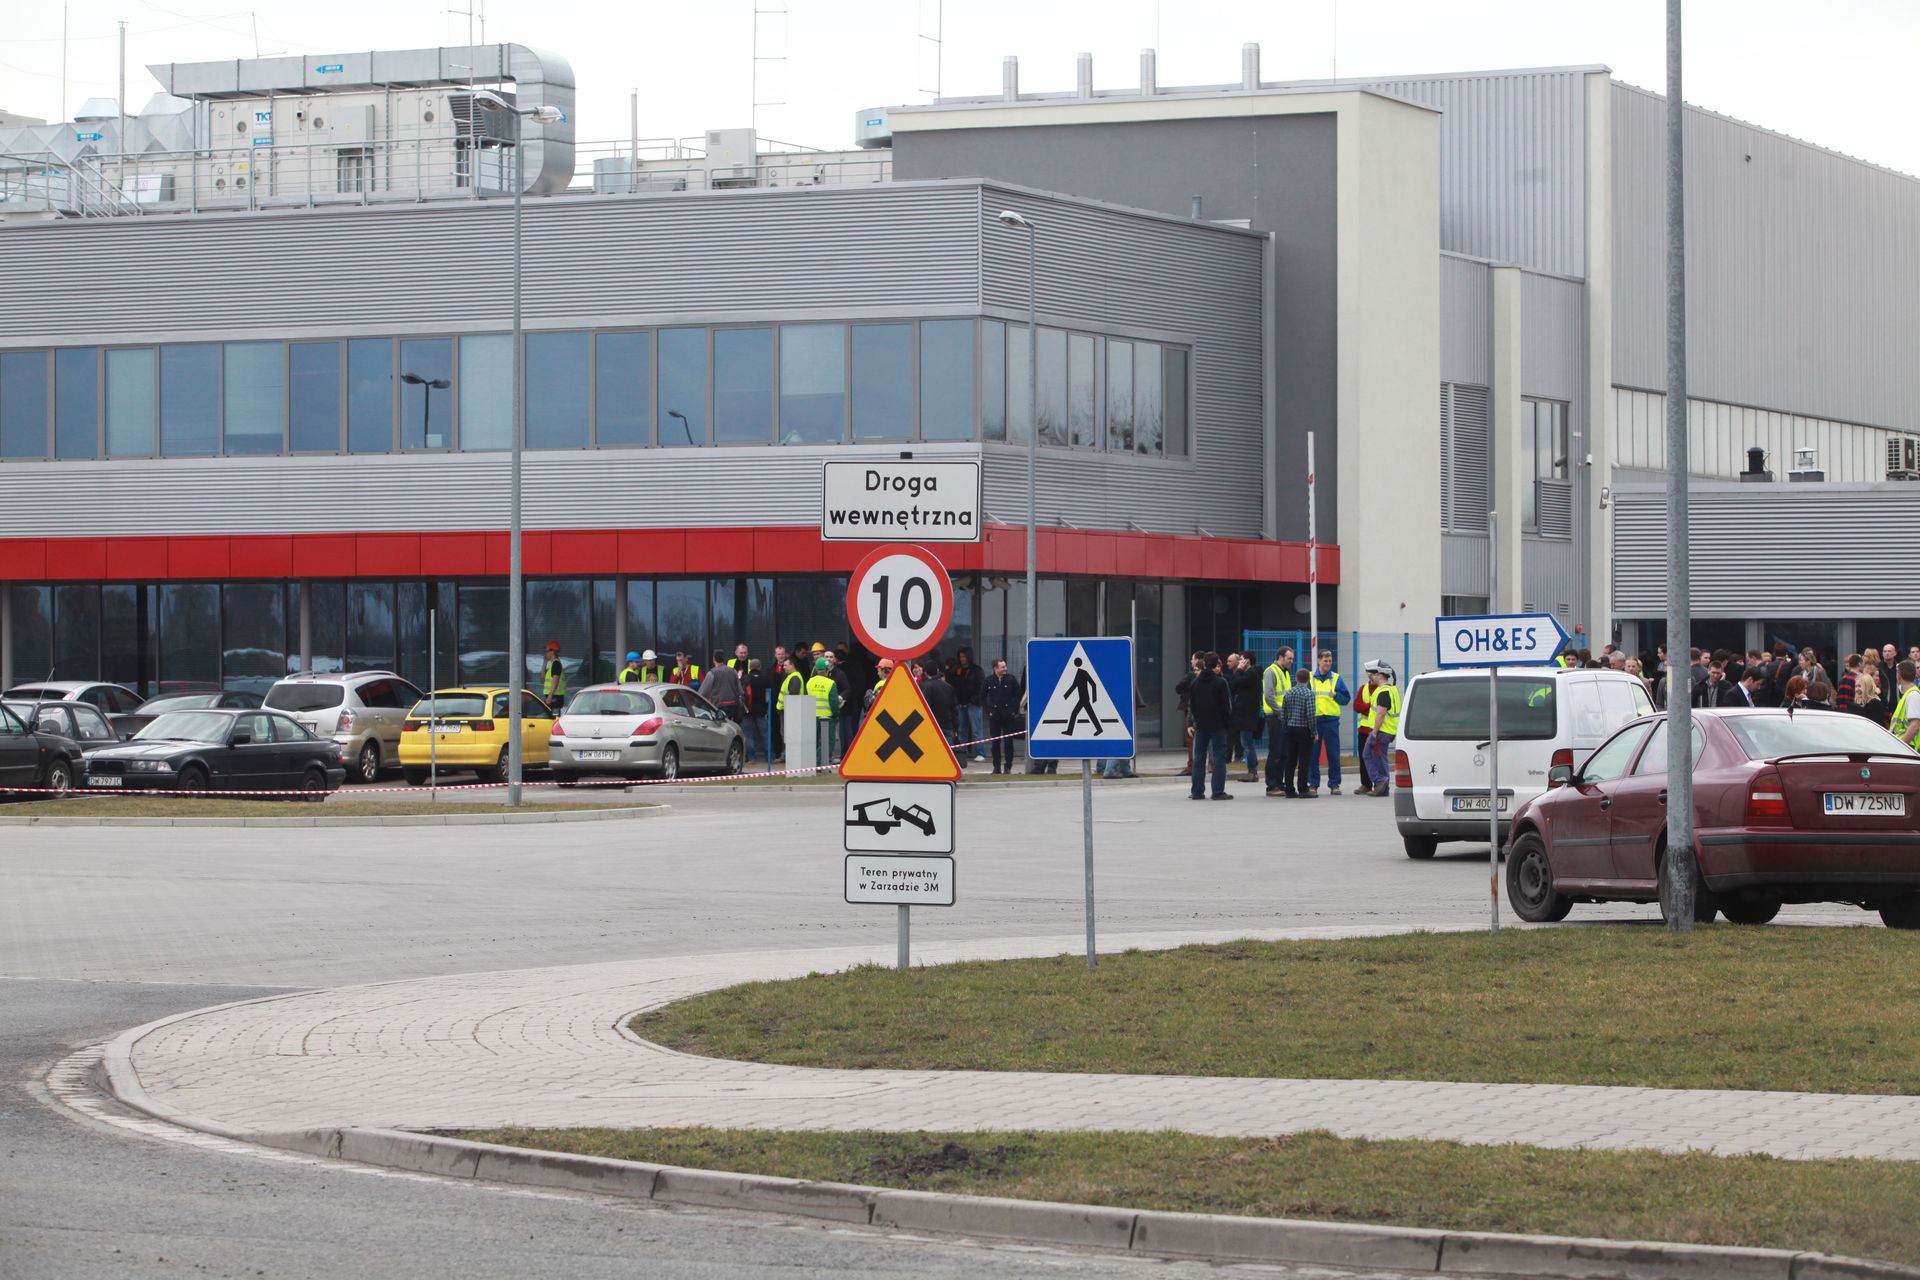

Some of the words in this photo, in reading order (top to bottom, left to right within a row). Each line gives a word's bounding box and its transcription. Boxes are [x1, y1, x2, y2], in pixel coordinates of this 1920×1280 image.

[866, 470, 937, 498] Droga
[830, 505, 972, 531] wewnętrzna
[872, 576, 933, 631] 10
[1455, 627, 1537, 653] OH&ES
[1458, 799, 1475, 808] DW
[1834, 796, 1854, 810] DW
[1859, 796, 1901, 811] 725NU
[860, 867, 888, 877] Teren
[892, 869, 938, 881] prywatny
[923, 882, 939, 892] 3M
